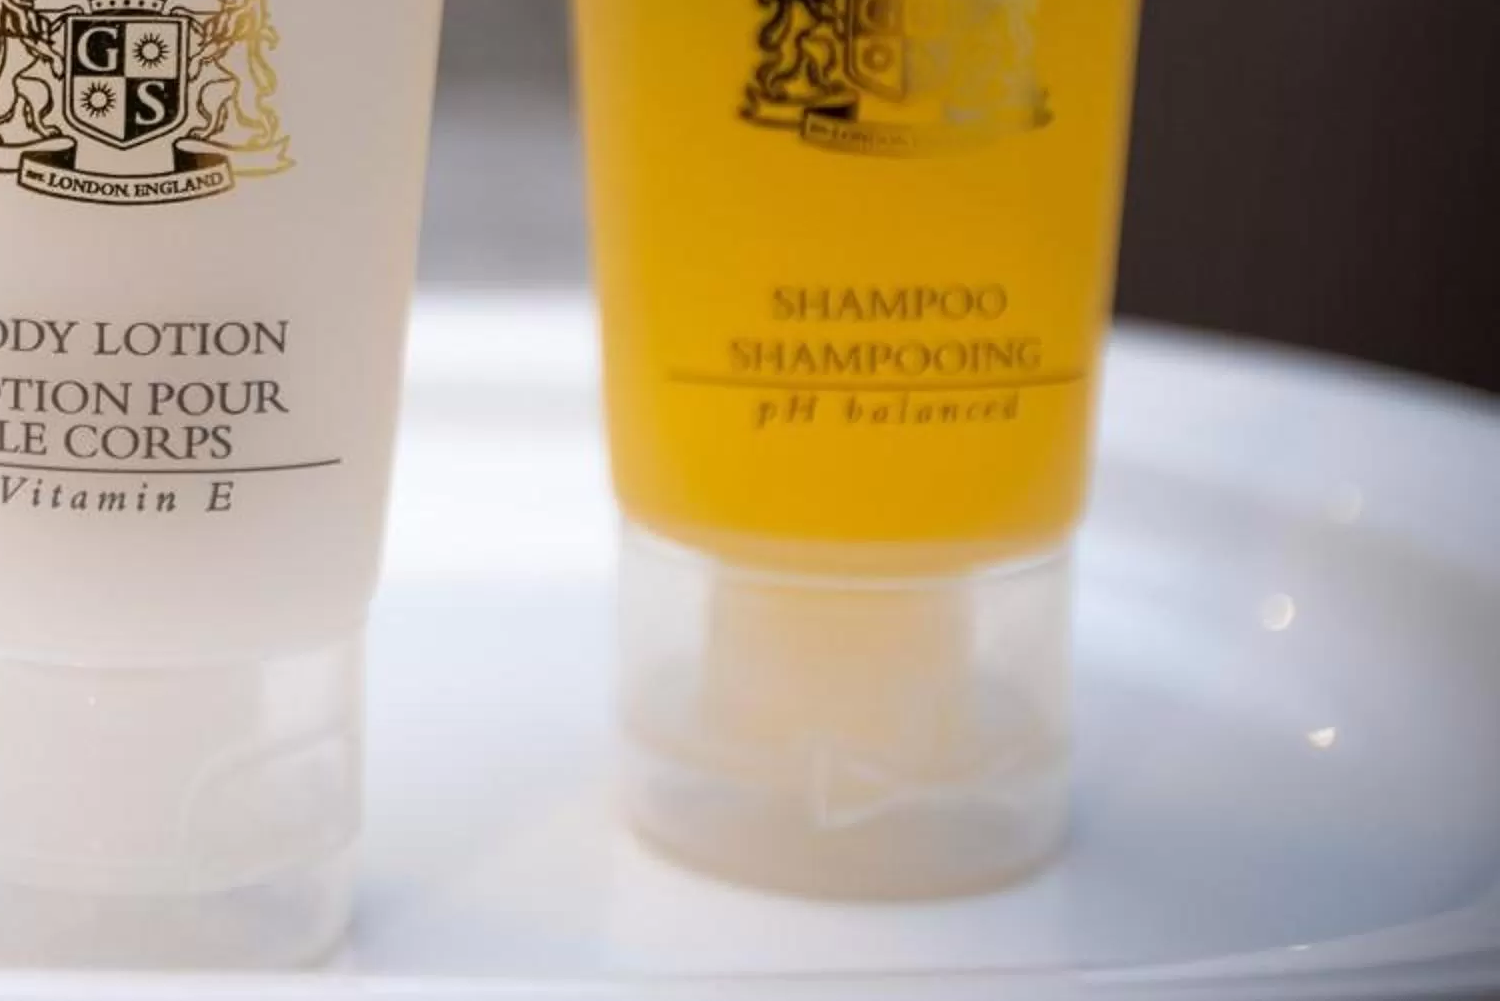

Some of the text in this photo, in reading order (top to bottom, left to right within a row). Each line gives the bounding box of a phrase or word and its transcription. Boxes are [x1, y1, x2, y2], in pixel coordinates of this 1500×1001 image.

[77, 27, 118, 72] G
[135, 81, 165, 125] S
[134, 172, 223, 197] ENGLAND
[772, 284, 1007, 322] SHAMPOO
[94, 320, 289, 356] LOTION
[729, 337, 1043, 376] SHAMPOOING
[148, 380, 289, 416] POUR
[756, 392, 1021, 429] pH balanced
[64, 425, 232, 459] CORPS
[1, 475, 235, 513] Vitamin E
